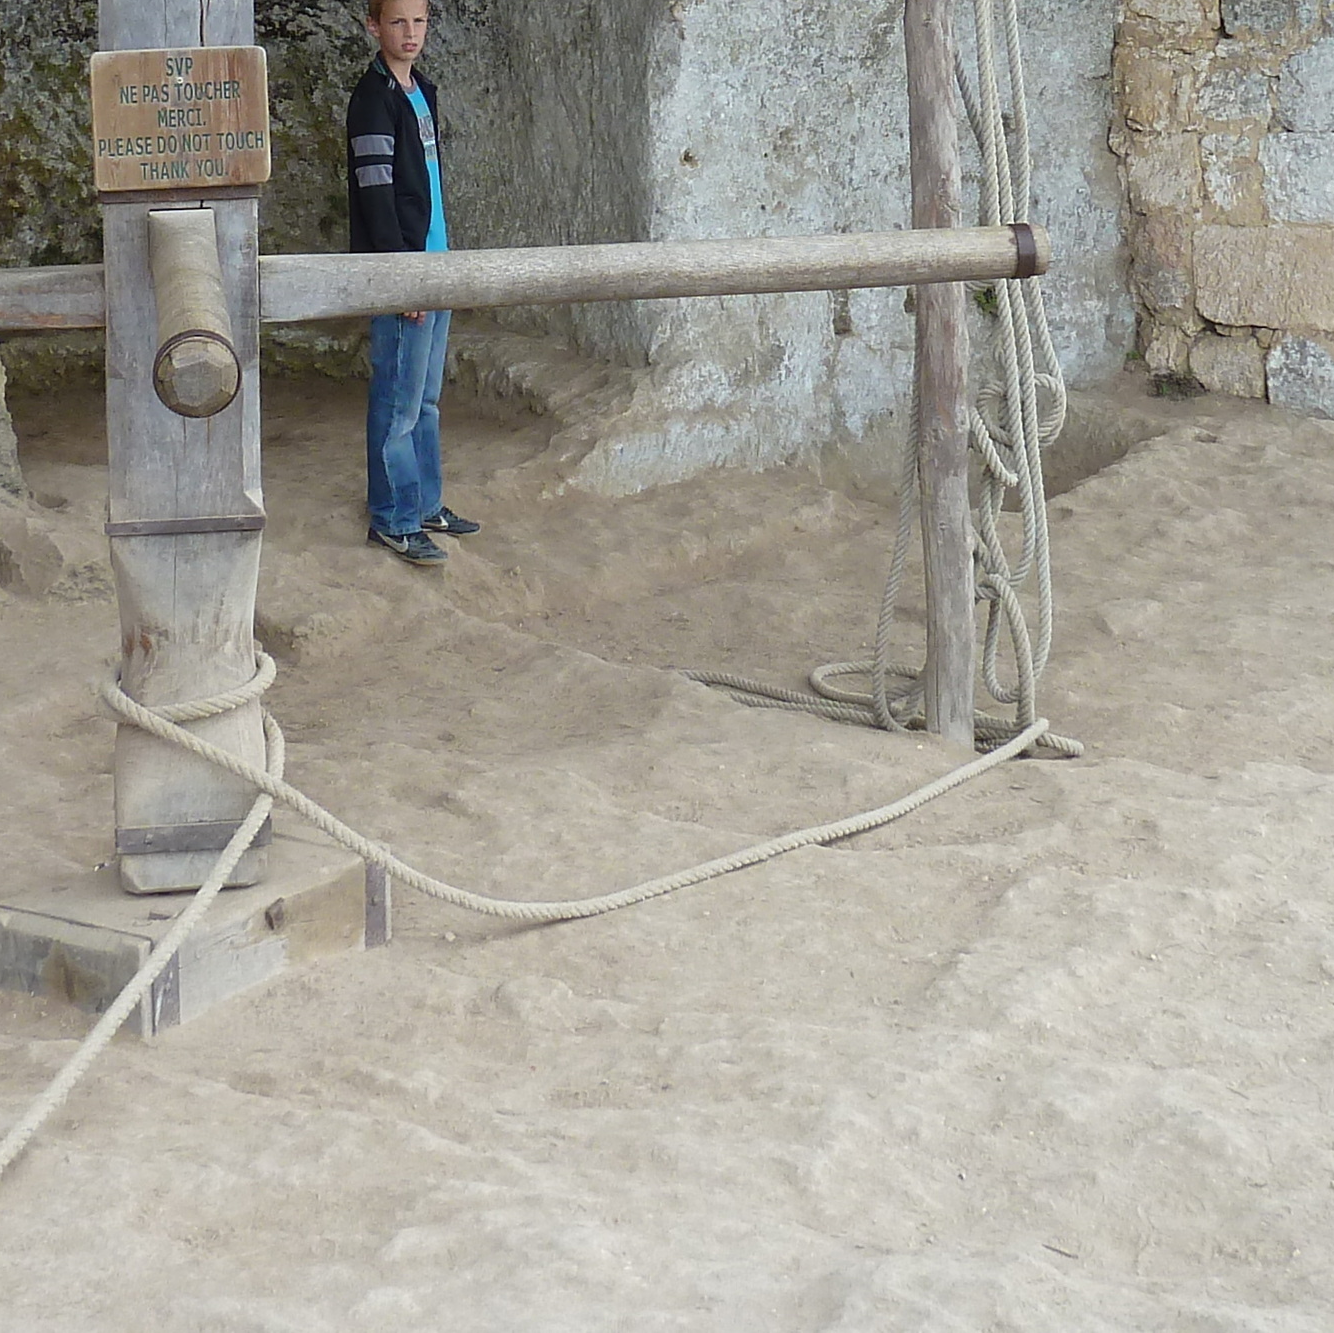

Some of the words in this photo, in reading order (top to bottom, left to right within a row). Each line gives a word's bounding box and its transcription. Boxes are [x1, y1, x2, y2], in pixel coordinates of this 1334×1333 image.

[166, 57, 193, 77] SVP
[120, 85, 138, 104] NE
[143, 84, 169, 103] PAS
[174, 80, 241, 102] TOUCHER
[157, 108, 206, 128] MERCI.
[98, 136, 152, 157] PLEASE
[157, 135, 177, 154] DO
[182, 133, 211, 152] NOT
[216, 131, 264, 151] TOUCH
[140, 161, 190, 180] THANK
[196, 159, 228, 178] YOU.
